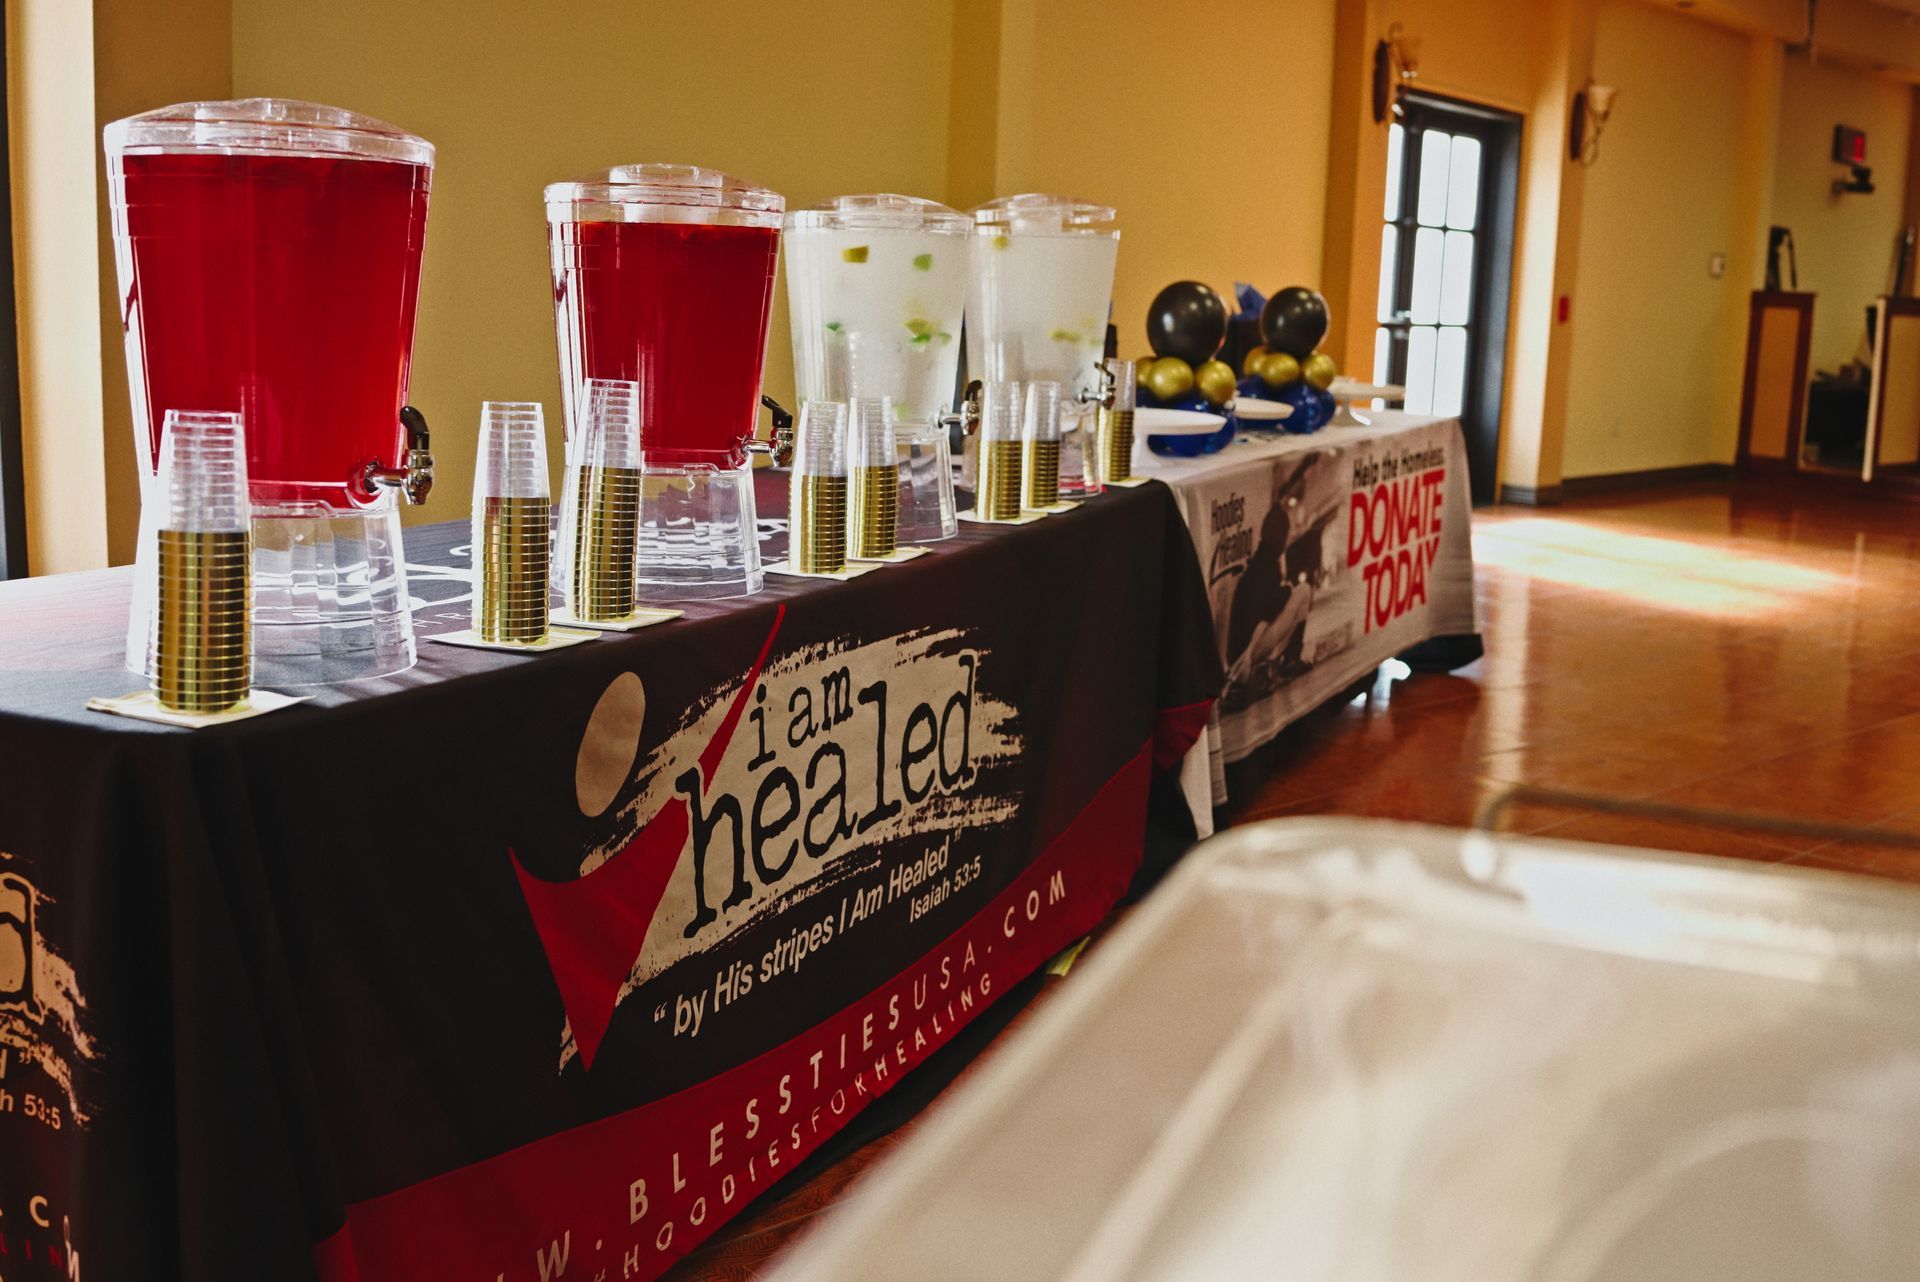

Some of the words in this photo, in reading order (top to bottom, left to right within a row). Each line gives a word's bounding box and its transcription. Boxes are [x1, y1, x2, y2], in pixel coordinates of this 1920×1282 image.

[1347, 468, 1445, 569] DONATE
[1353, 455, 1379, 494] Help
[1382, 451, 1398, 481] the
[1363, 537, 1440, 635] TODAY
[747, 683, 776, 772] i
[787, 666, 853, 748] am
[675, 651, 977, 939] healed
[713, 960, 754, 1013] His
[759, 913, 834, 983] stripes
[838, 898, 848, 935] I
[849, 884, 883, 928] Am
[888, 843, 950, 903] Healed
[910, 880, 950, 923] Isaiah
[953, 855, 981, 893] 53:5
[24, 1093, 62, 1130] 53:5
[496, 869, 1067, 1282] W.BLESSTIESUSA.COM
